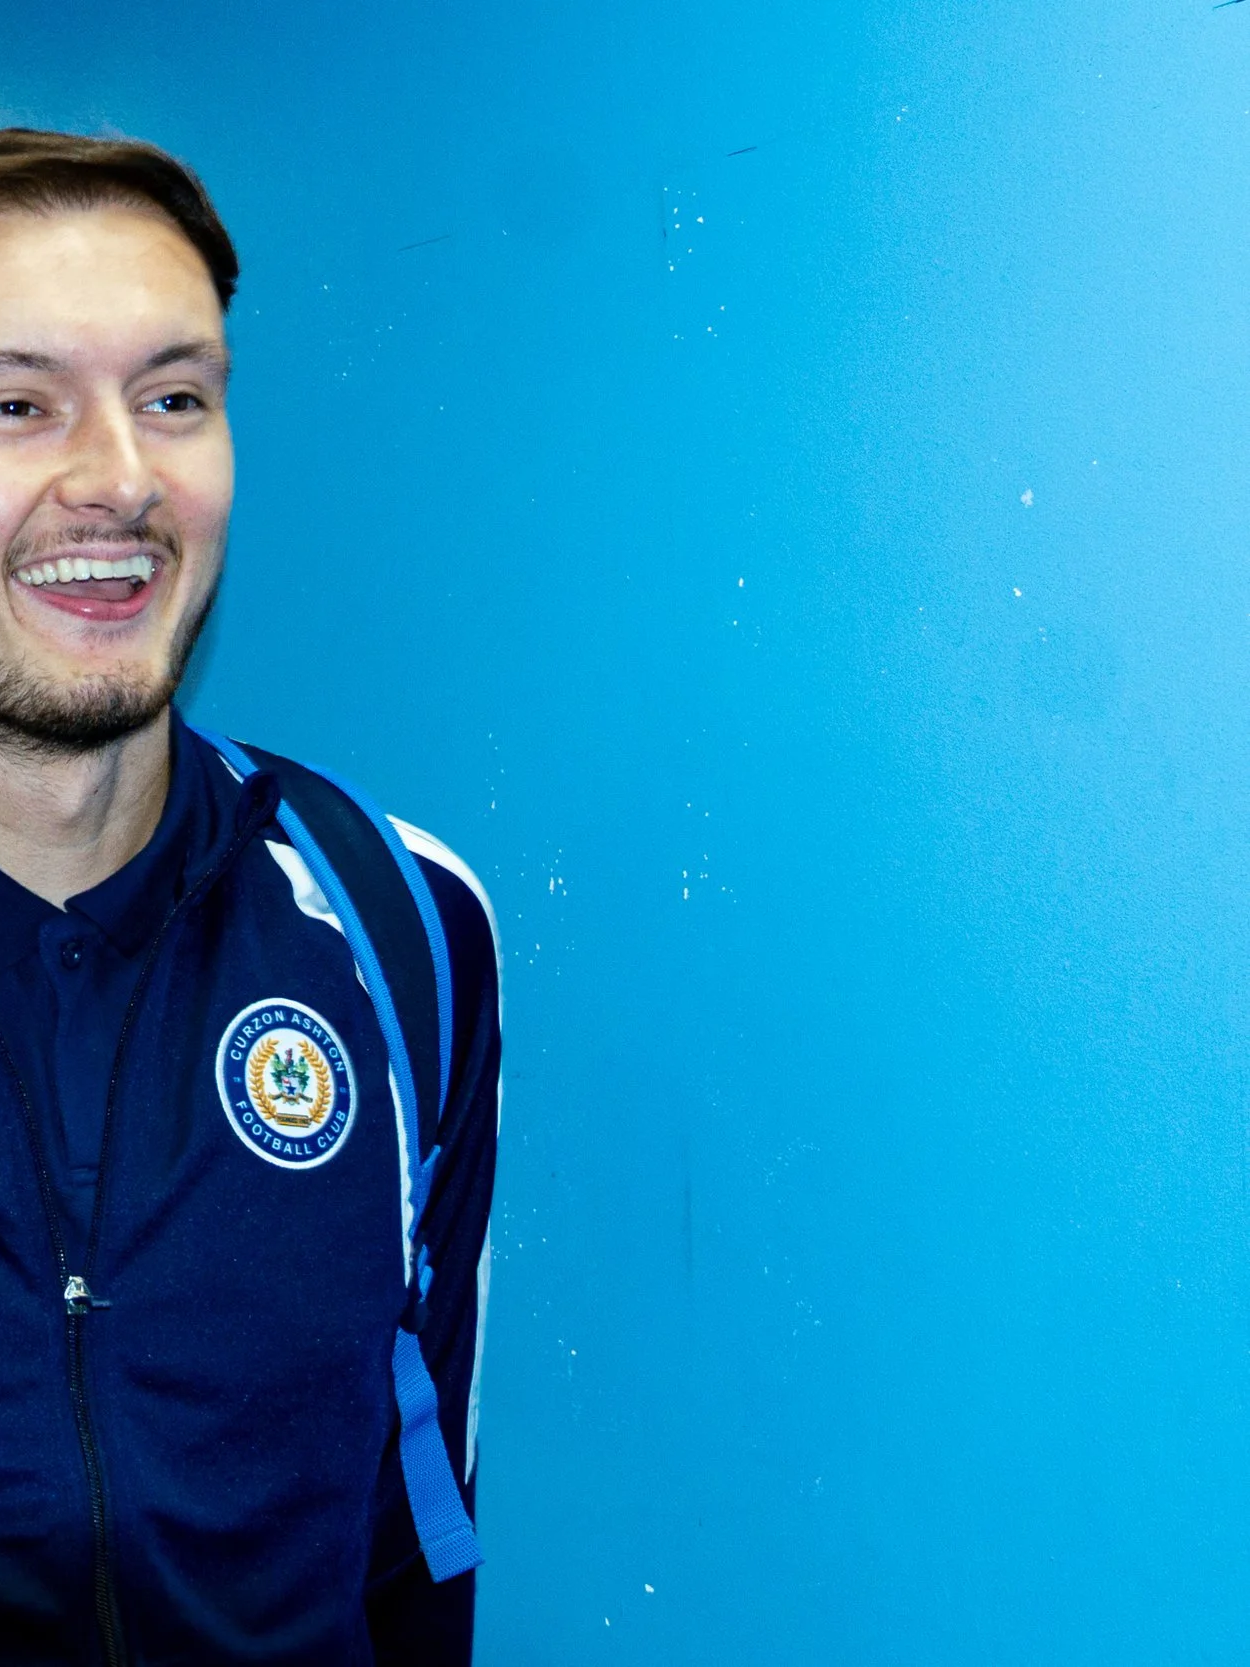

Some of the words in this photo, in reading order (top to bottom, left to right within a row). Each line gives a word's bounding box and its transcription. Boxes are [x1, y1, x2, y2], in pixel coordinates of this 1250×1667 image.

[230, 1010, 285, 1061] CURZON
[291, 1013, 345, 1072] ASHTON
[235, 1100, 313, 1155] FOOTBALL
[317, 1110, 347, 1148] CLUB
